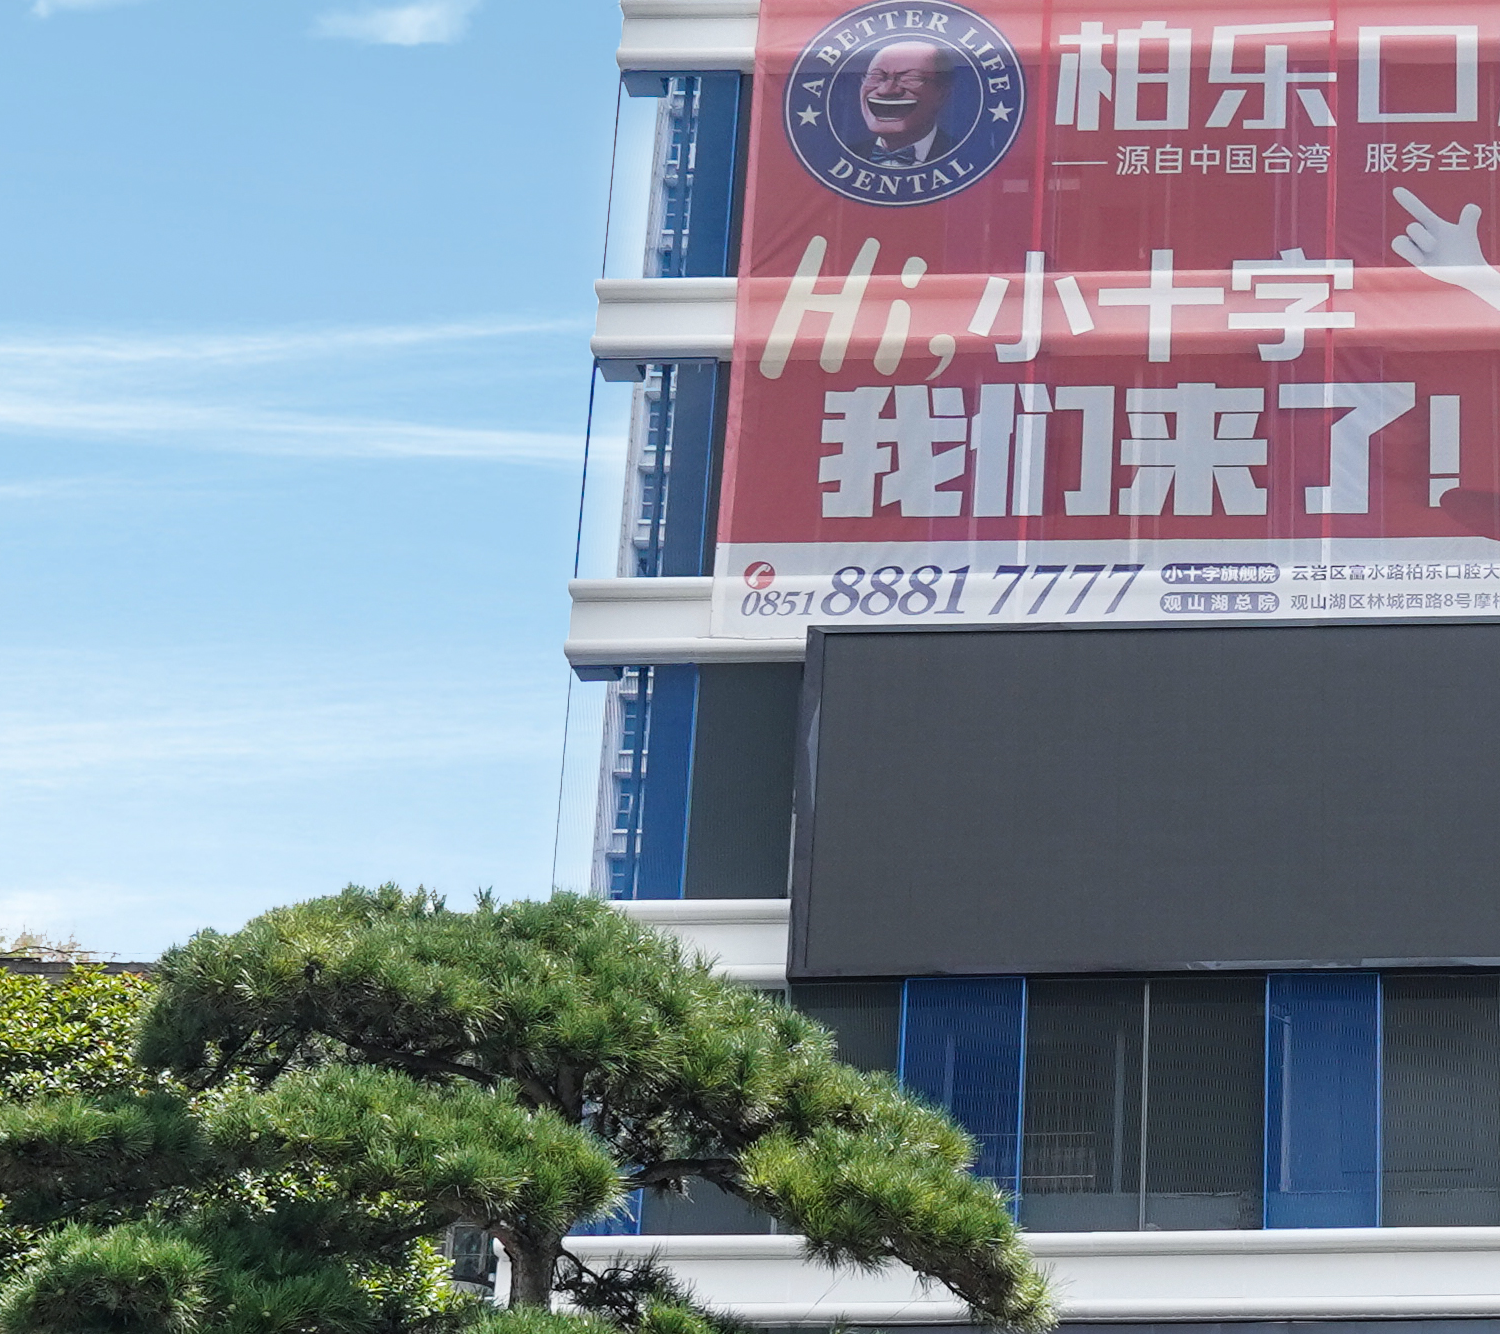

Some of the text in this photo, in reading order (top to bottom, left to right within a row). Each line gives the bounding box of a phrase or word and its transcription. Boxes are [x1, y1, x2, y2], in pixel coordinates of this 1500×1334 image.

[802, 10, 1011, 98] A BETTER LIFE
[828, 157, 974, 195] DENTAL
[1116, 143, 1332, 178] 源自中国台湾
[968, 247, 1357, 364] 小十字
[740, 563, 1145, 617] 0851 8881 7777
[1165, 564, 1277, 584] 小十字旗舰院
[1162, 593, 1277, 612] 观山湖总院
